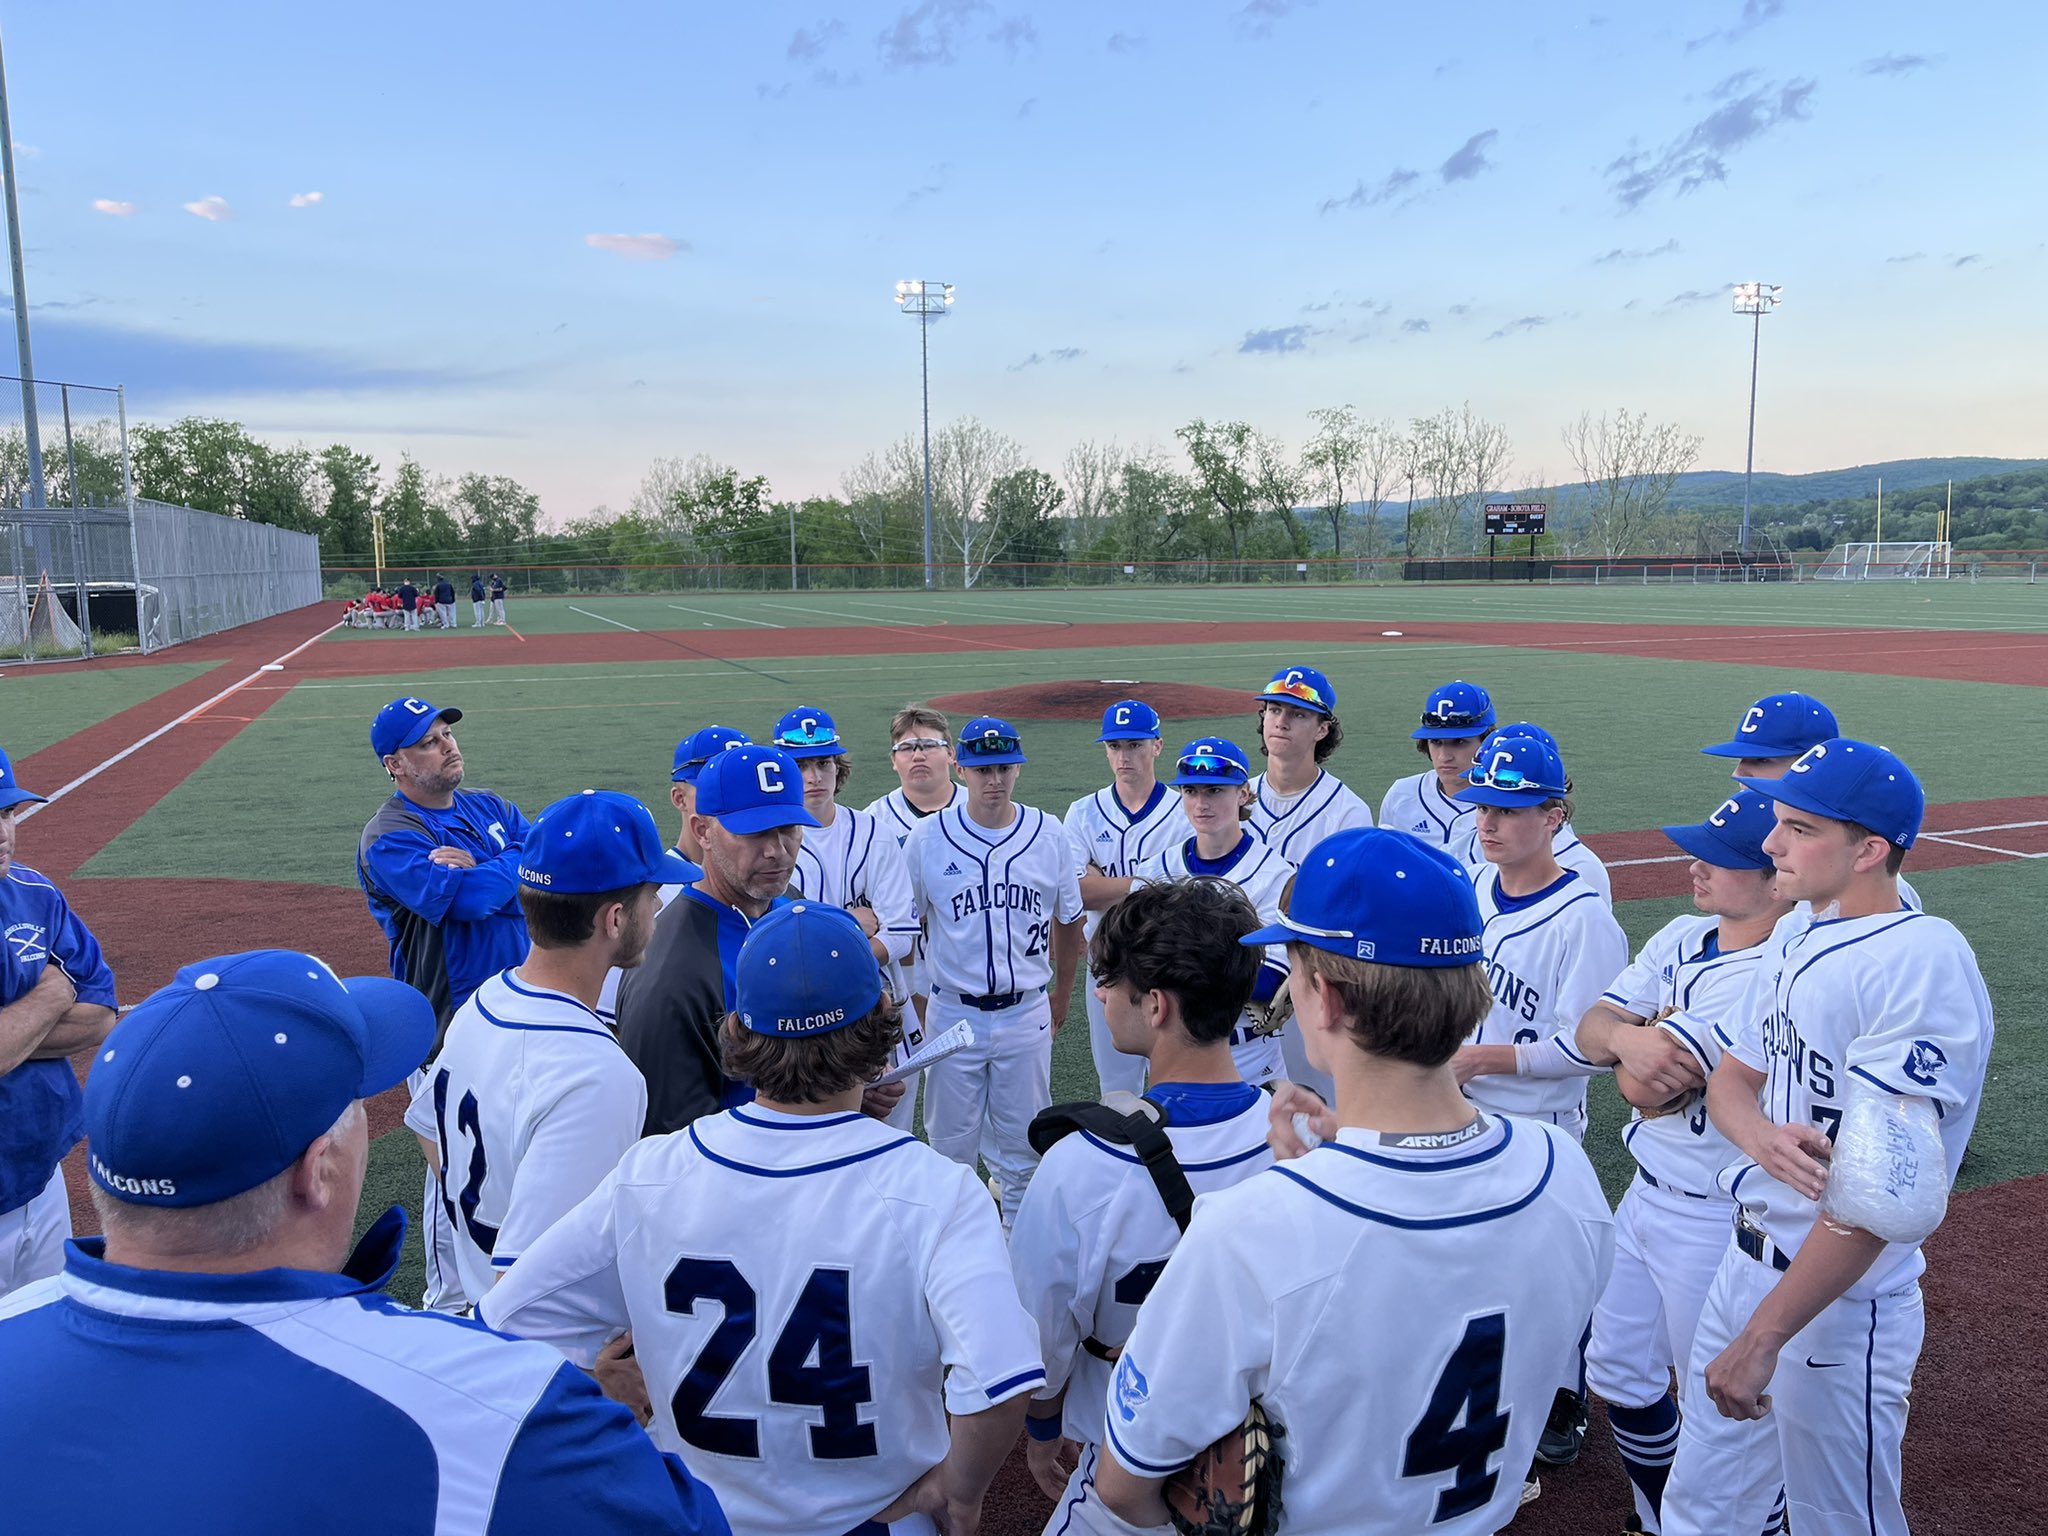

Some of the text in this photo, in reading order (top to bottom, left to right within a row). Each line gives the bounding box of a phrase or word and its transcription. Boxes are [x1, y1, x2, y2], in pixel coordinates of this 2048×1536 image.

[403, 698, 429, 715] C
[1115, 707, 1131, 725] C
[1437, 699, 1454, 721] C
[1740, 706, 1764, 733] C
[800, 717, 817, 738] C
[1790, 743, 1828, 774] C
[755, 760, 786, 794] C
[1709, 799, 1741, 827] C
[950, 882, 1042, 923] FALCONS
[1024, 919, 1050, 957] 29
[1420, 936, 1482, 956] FALCONS
[777, 1008, 846, 1032] FALCONS
[1762, 1011, 1835, 1099] FALCONS
[1396, 1122, 1481, 1148] ARMOUR
[1811, 1104, 1844, 1148] 7
[433, 1067, 500, 1256] 12
[663, 1253, 880, 1462] 24
[1402, 1304, 1515, 1527] 4
